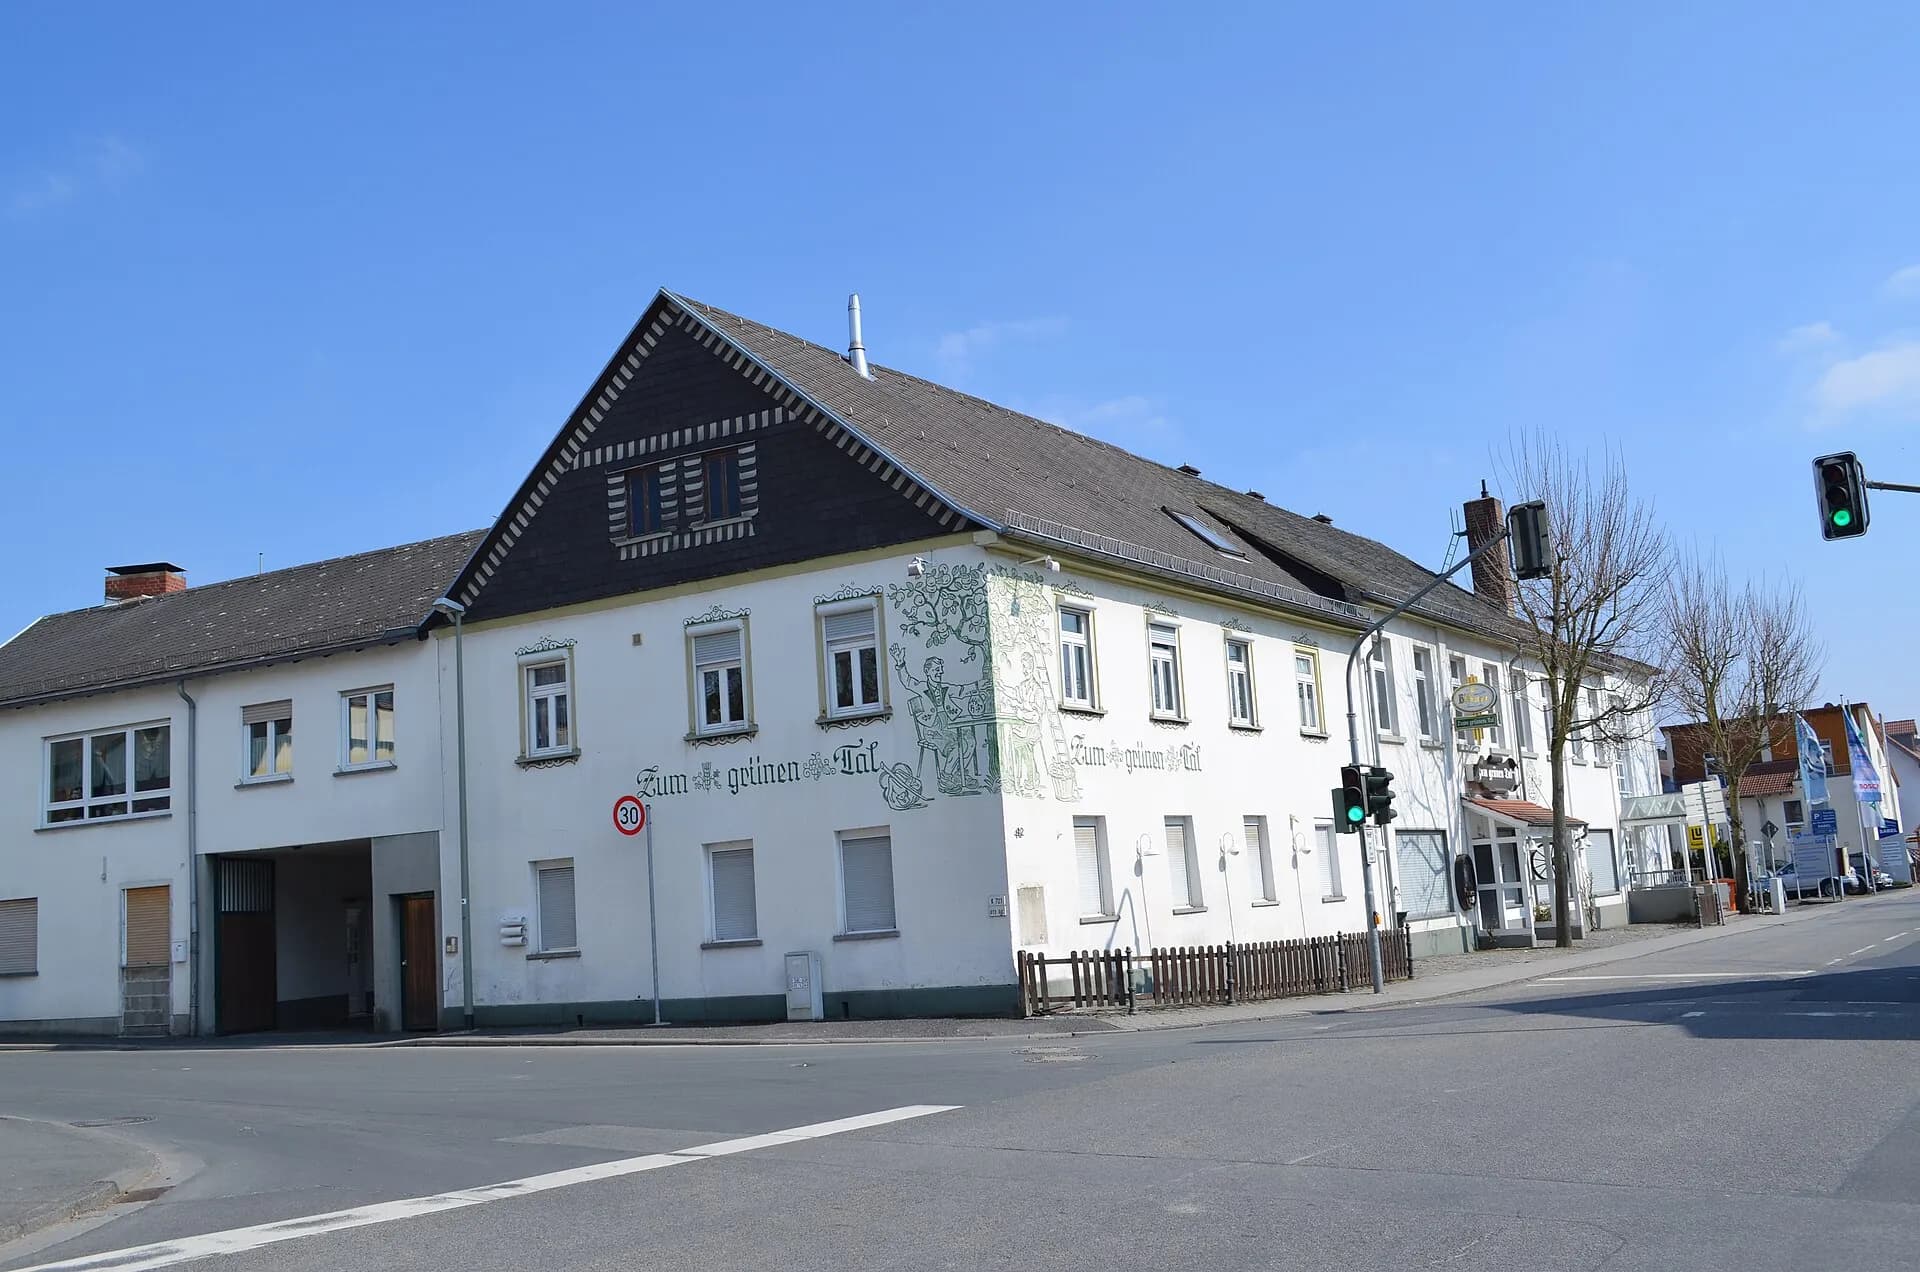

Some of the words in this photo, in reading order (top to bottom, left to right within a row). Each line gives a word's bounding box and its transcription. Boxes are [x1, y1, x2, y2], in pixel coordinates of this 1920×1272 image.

[636, 765, 689, 798] Zum
[727, 755, 801, 795] grünen
[832, 738, 881, 775] Tal
[1071, 733, 1106, 766] Zum
[1125, 740, 1164, 774] grünen
[1180, 741, 1202, 772] Tal
[619, 806, 639, 825] 30
